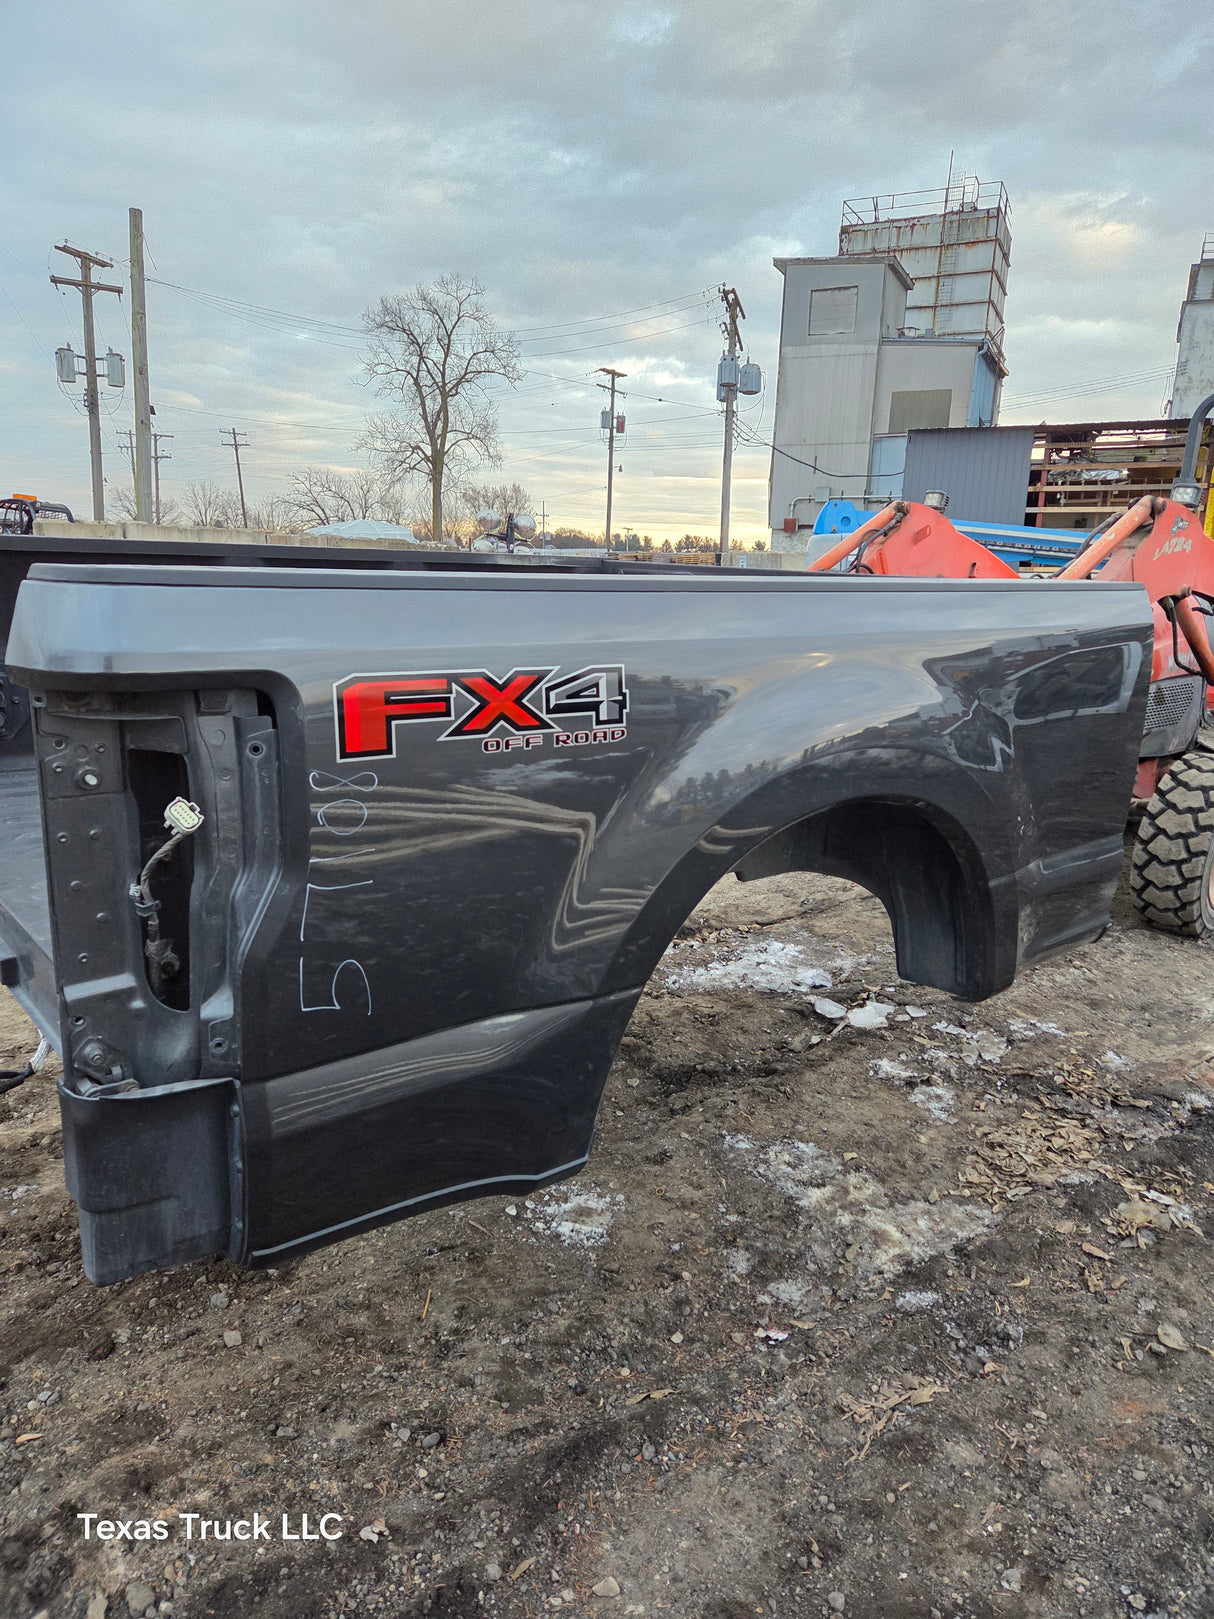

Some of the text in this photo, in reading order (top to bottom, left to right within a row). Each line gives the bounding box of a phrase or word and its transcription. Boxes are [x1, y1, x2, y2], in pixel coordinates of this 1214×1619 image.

[332, 664, 629, 763] FX4
[482, 728, 627, 754] OFF ROAD
[300, 770, 379, 1015] 57108
